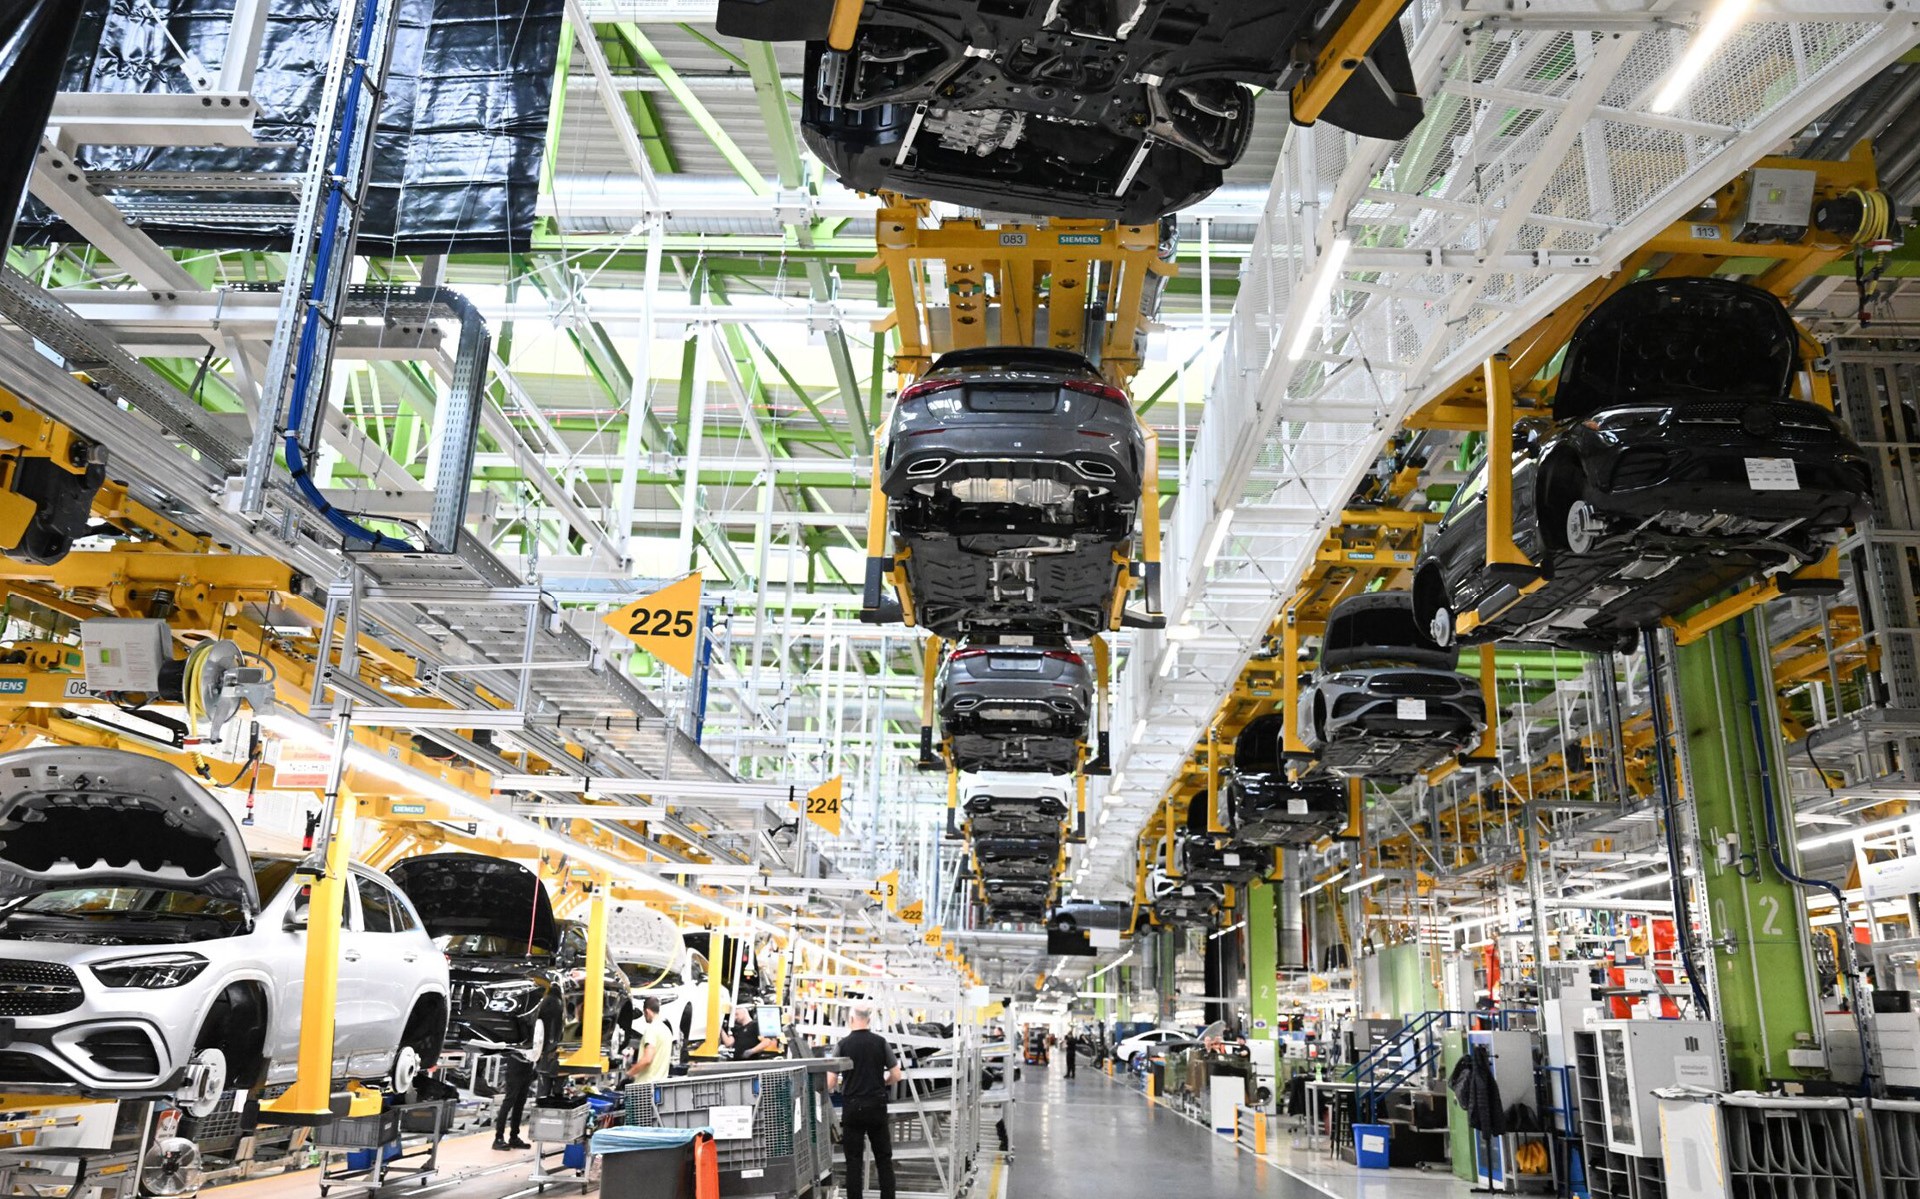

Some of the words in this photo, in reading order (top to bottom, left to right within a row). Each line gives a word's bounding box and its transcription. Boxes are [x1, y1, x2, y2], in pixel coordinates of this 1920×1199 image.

[1696, 227, 1715, 237] 113
[1002, 234, 1024, 244] 083
[628, 608, 693, 637] 225
[70, 681, 88, 694] 08
[806, 797, 838, 814] 224
[902, 910, 921, 919] 222
[1759, 896, 1783, 935] 2
